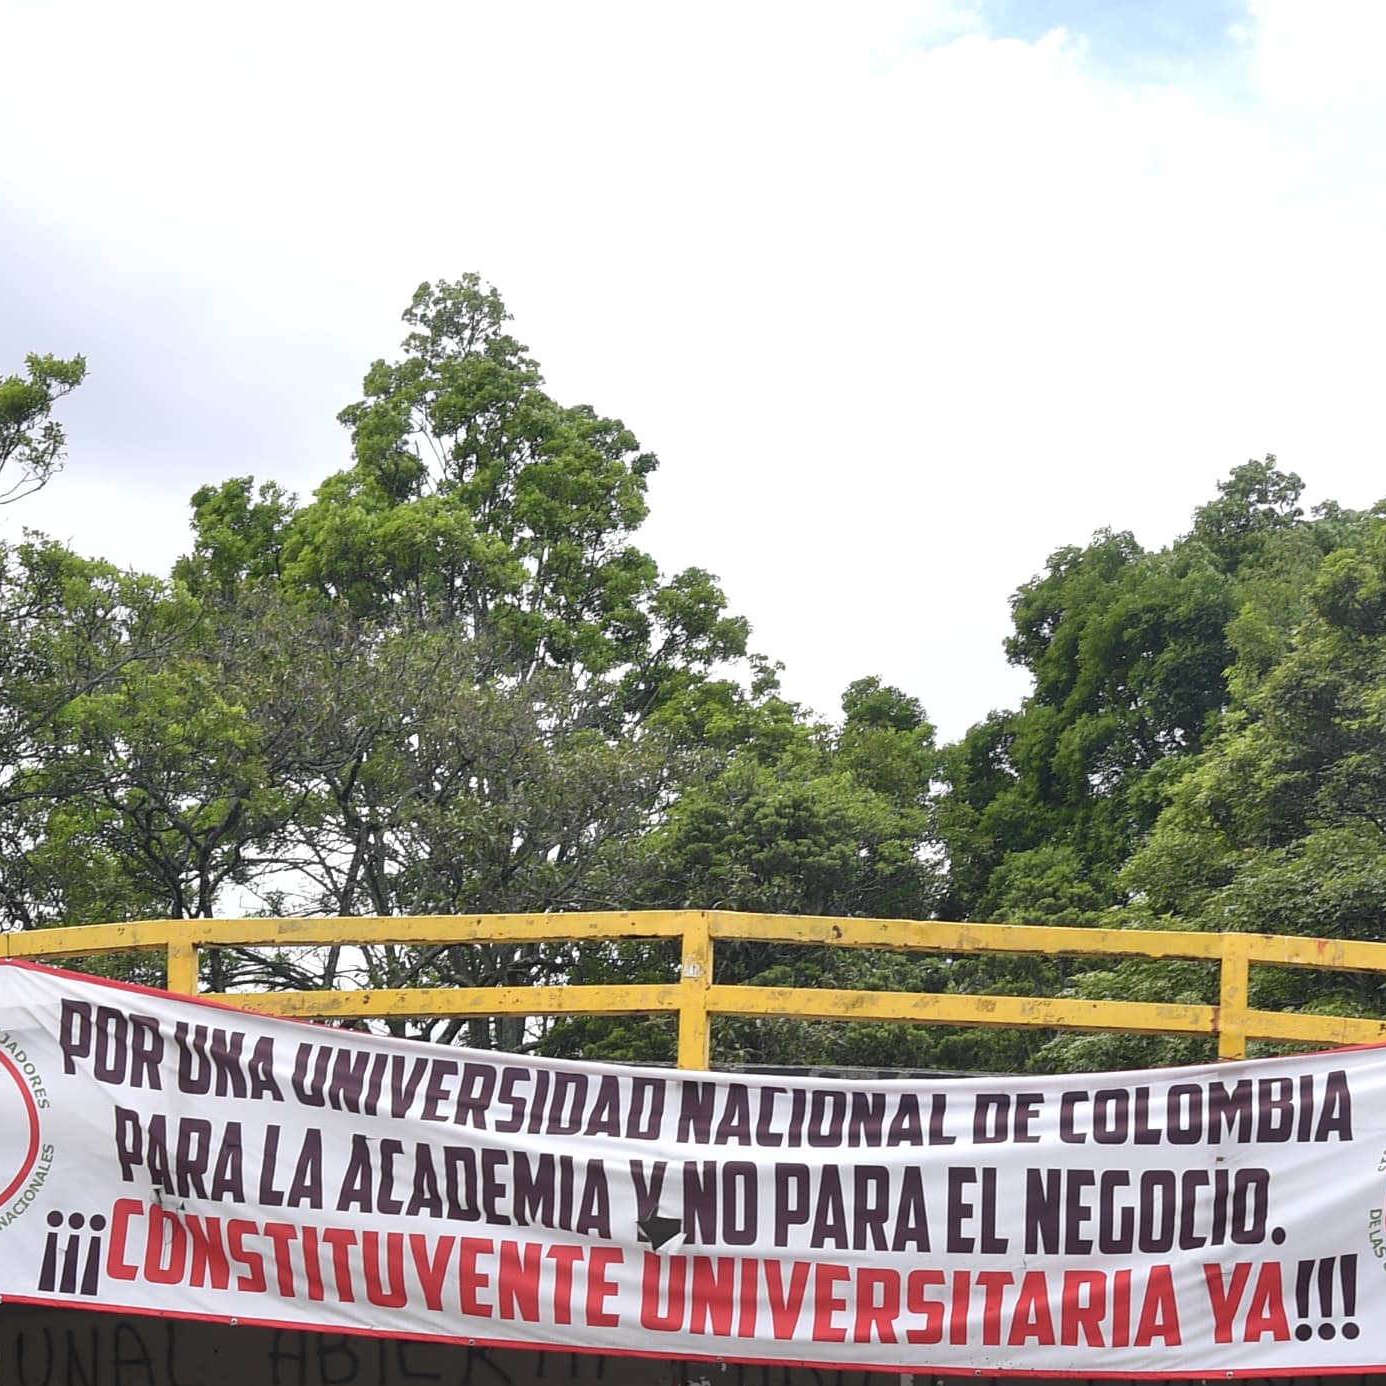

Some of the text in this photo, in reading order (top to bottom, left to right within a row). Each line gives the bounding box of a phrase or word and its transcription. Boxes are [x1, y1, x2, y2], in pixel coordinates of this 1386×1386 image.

[60, 999, 1353, 1148] POR UNA UNIVERSIDAD NACIONAL DE COLOMBIA
[115, 1105, 1286, 1255] PARA LA ACADEMIA Y NO PARA EL NEGOCIO.
[1369, 1208, 1382, 1228] DE
[641, 1253, 1181, 1347] UNIVERSITARIA
